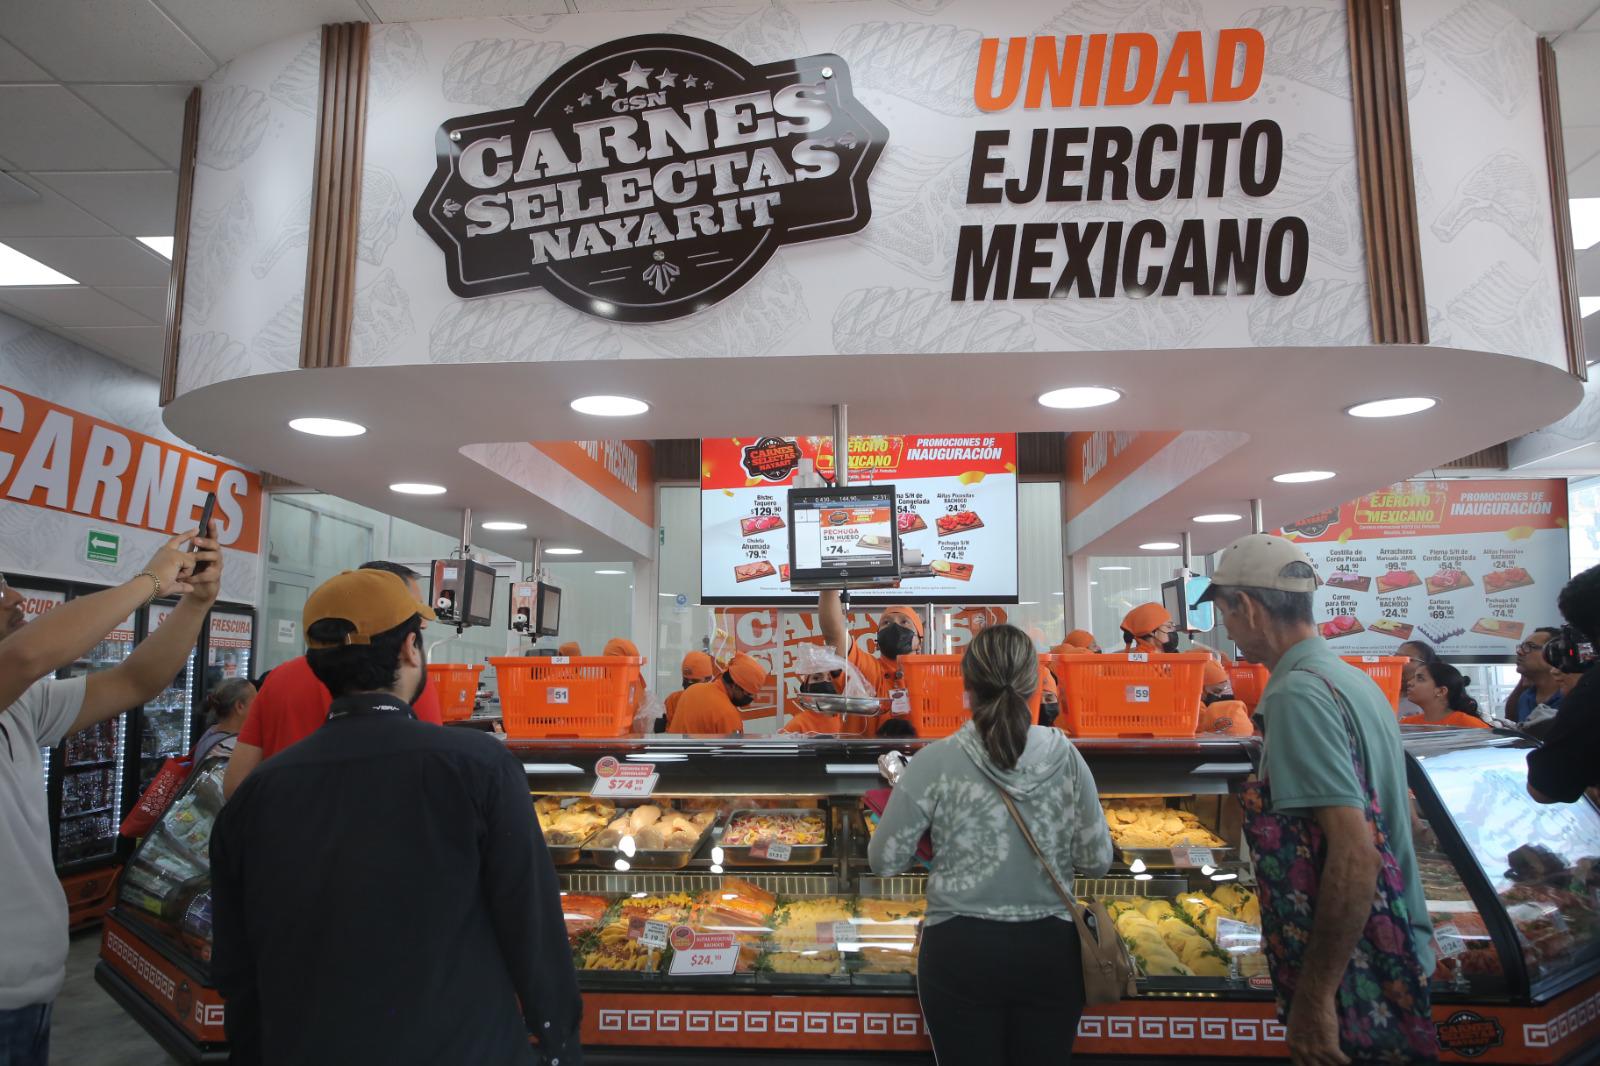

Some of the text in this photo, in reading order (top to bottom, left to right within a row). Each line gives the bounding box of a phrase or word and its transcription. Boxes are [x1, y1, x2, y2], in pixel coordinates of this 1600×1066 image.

[973, 28, 1265, 112] UNIDAD
[611, 91, 667, 113] CSN
[458, 82, 833, 189] CARNES
[966, 119, 1283, 205] EJERCITO
[464, 137, 841, 238] SELECTAS
[529, 192, 781, 265] NAYARIT
[951, 216, 1309, 301] MEXICANO
[917, 437, 995, 448] PROMOCIONES DE
[750, 446, 794, 458] CARNES
[751, 453, 796, 465] SELECTAS
[907, 446, 1002, 460] INAUGURACIÓN
[1371, 495, 1431, 507] EJERCITO
[1460, 492, 1545, 502] PROMOCIONES DE
[1451, 500, 1552, 516] INAUGURACIÓN
[1368, 510, 1435, 522] MEXICANO
[211, 618, 251, 634] FRESCURA
[555, 691, 567, 700] 51
[1136, 689, 1148, 698] 59
